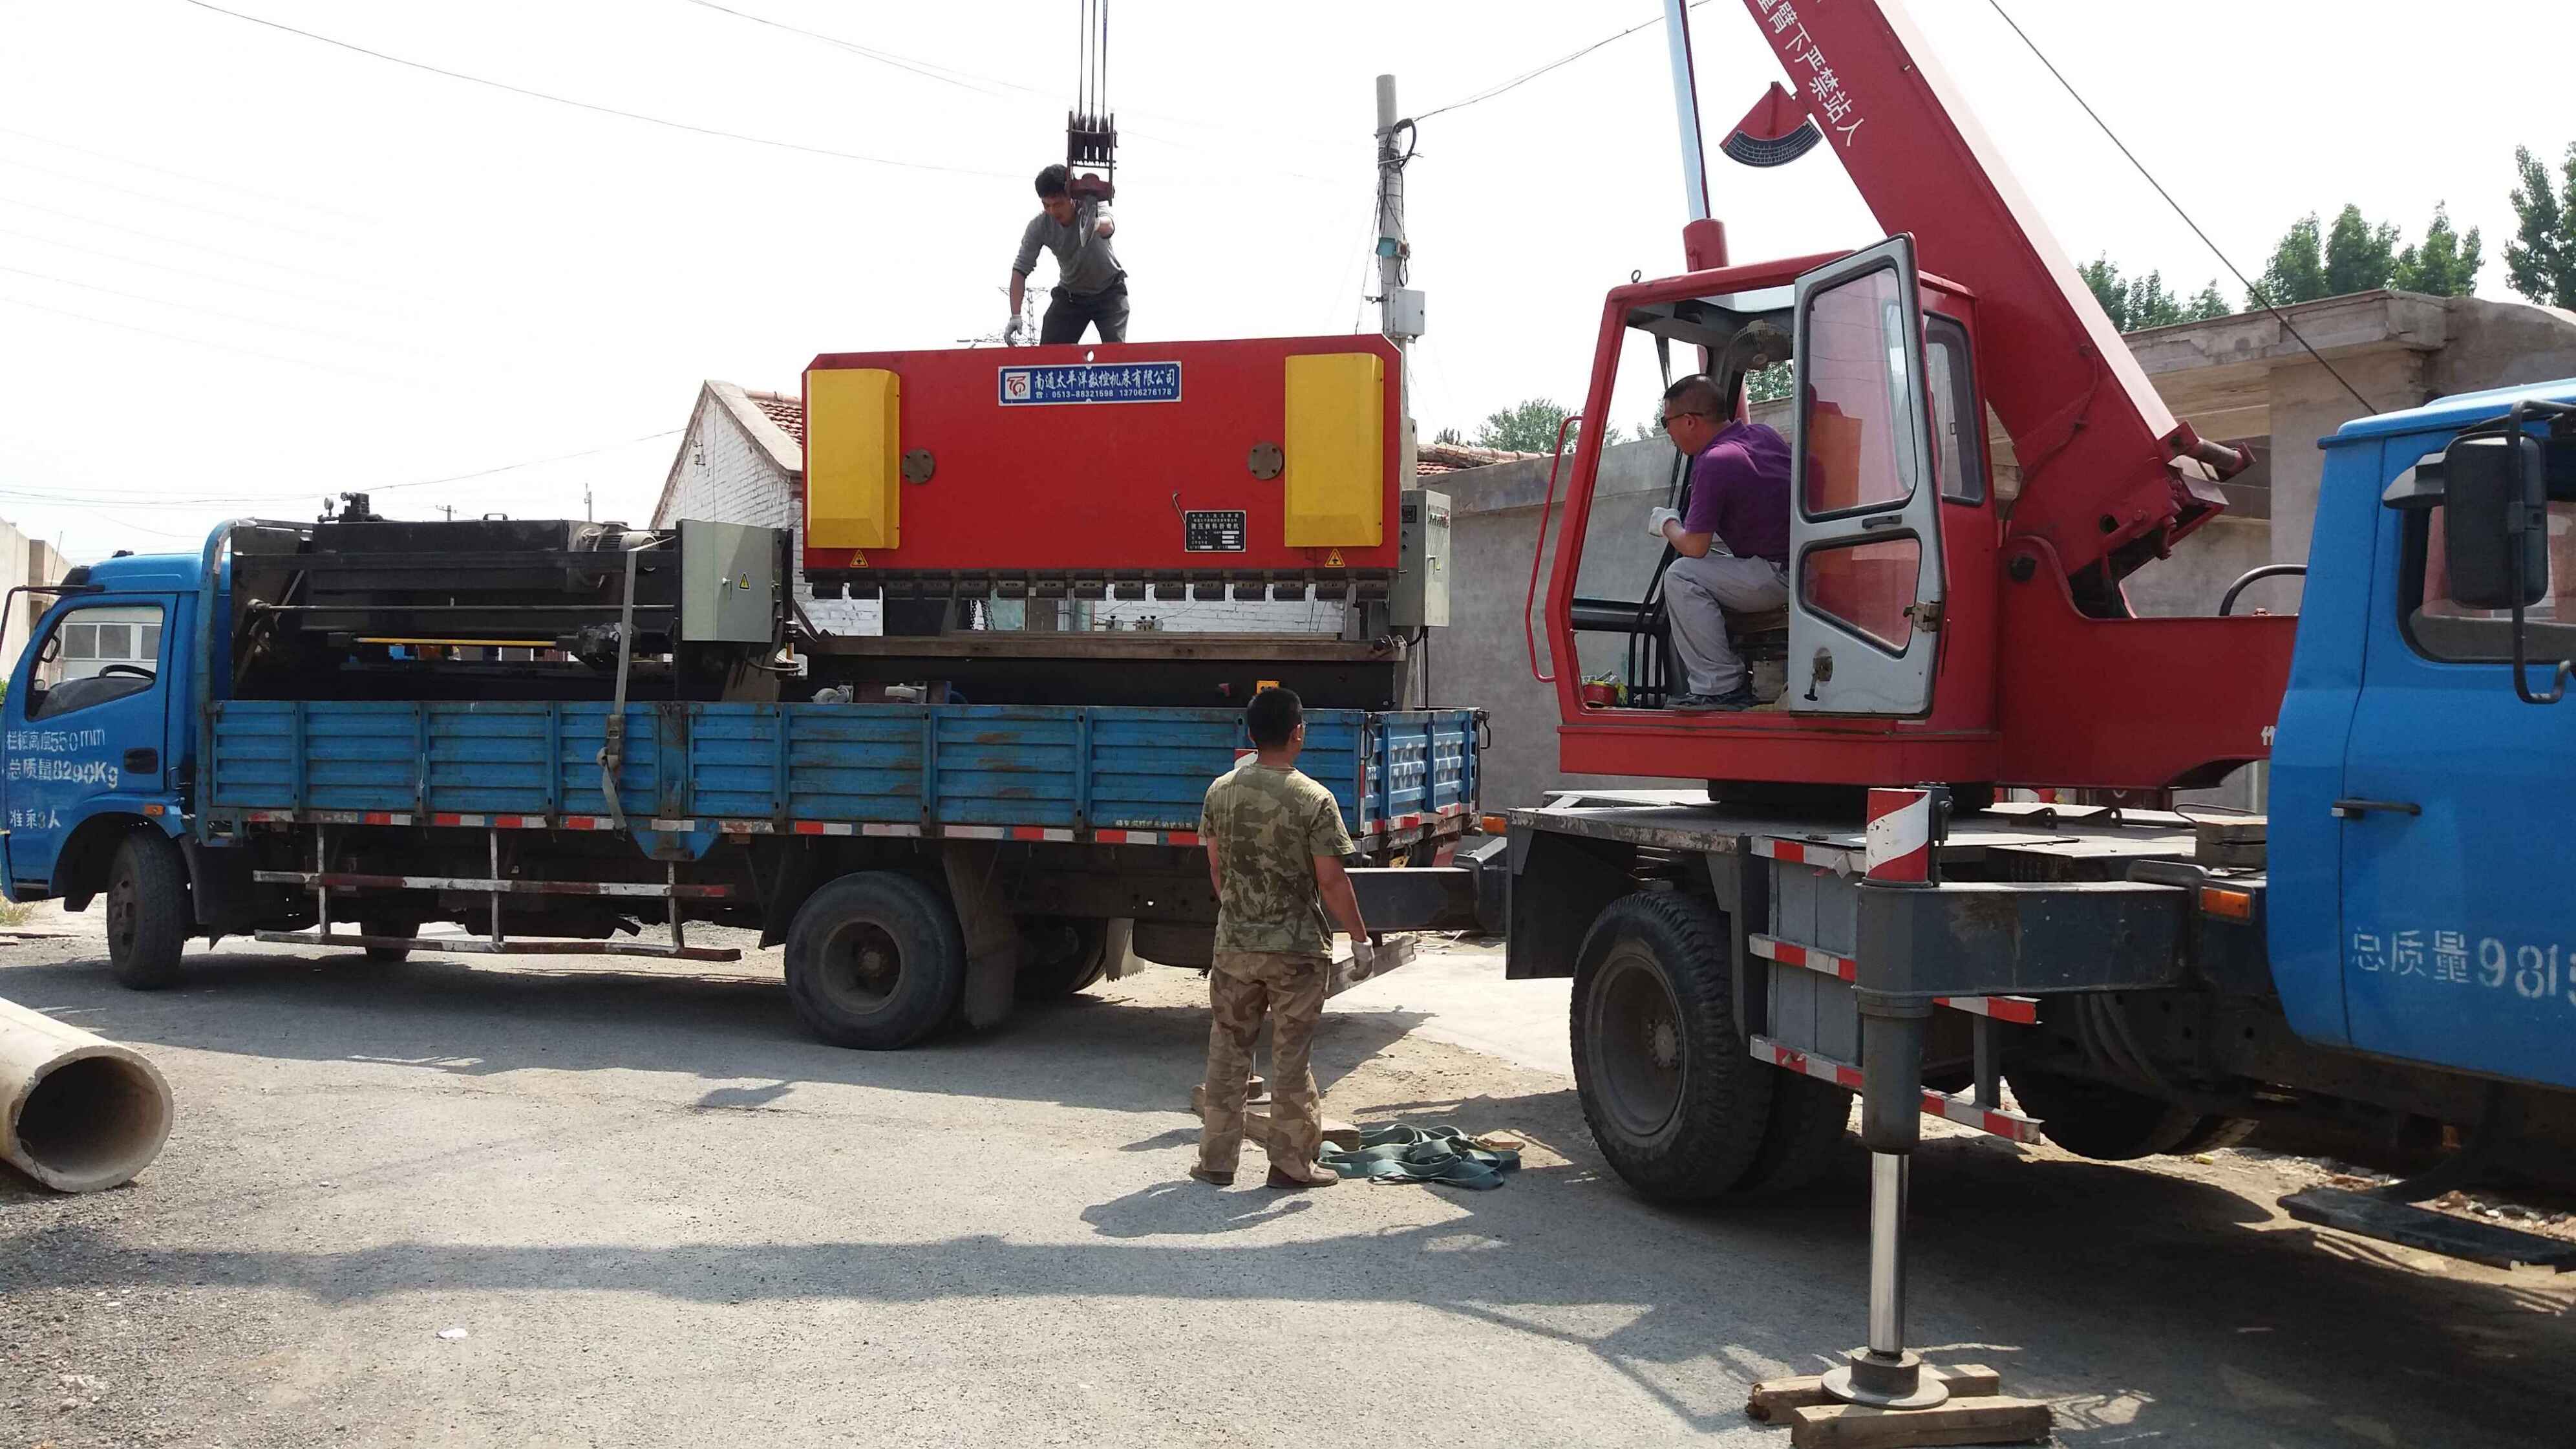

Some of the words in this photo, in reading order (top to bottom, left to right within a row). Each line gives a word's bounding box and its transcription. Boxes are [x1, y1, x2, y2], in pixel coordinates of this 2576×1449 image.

[1034, 369, 1175, 390] 南通太平洋数控机床有限公司
[1120, 388, 1172, 397] 13706276178
[10, 809, 61, 829] 准乘3人
